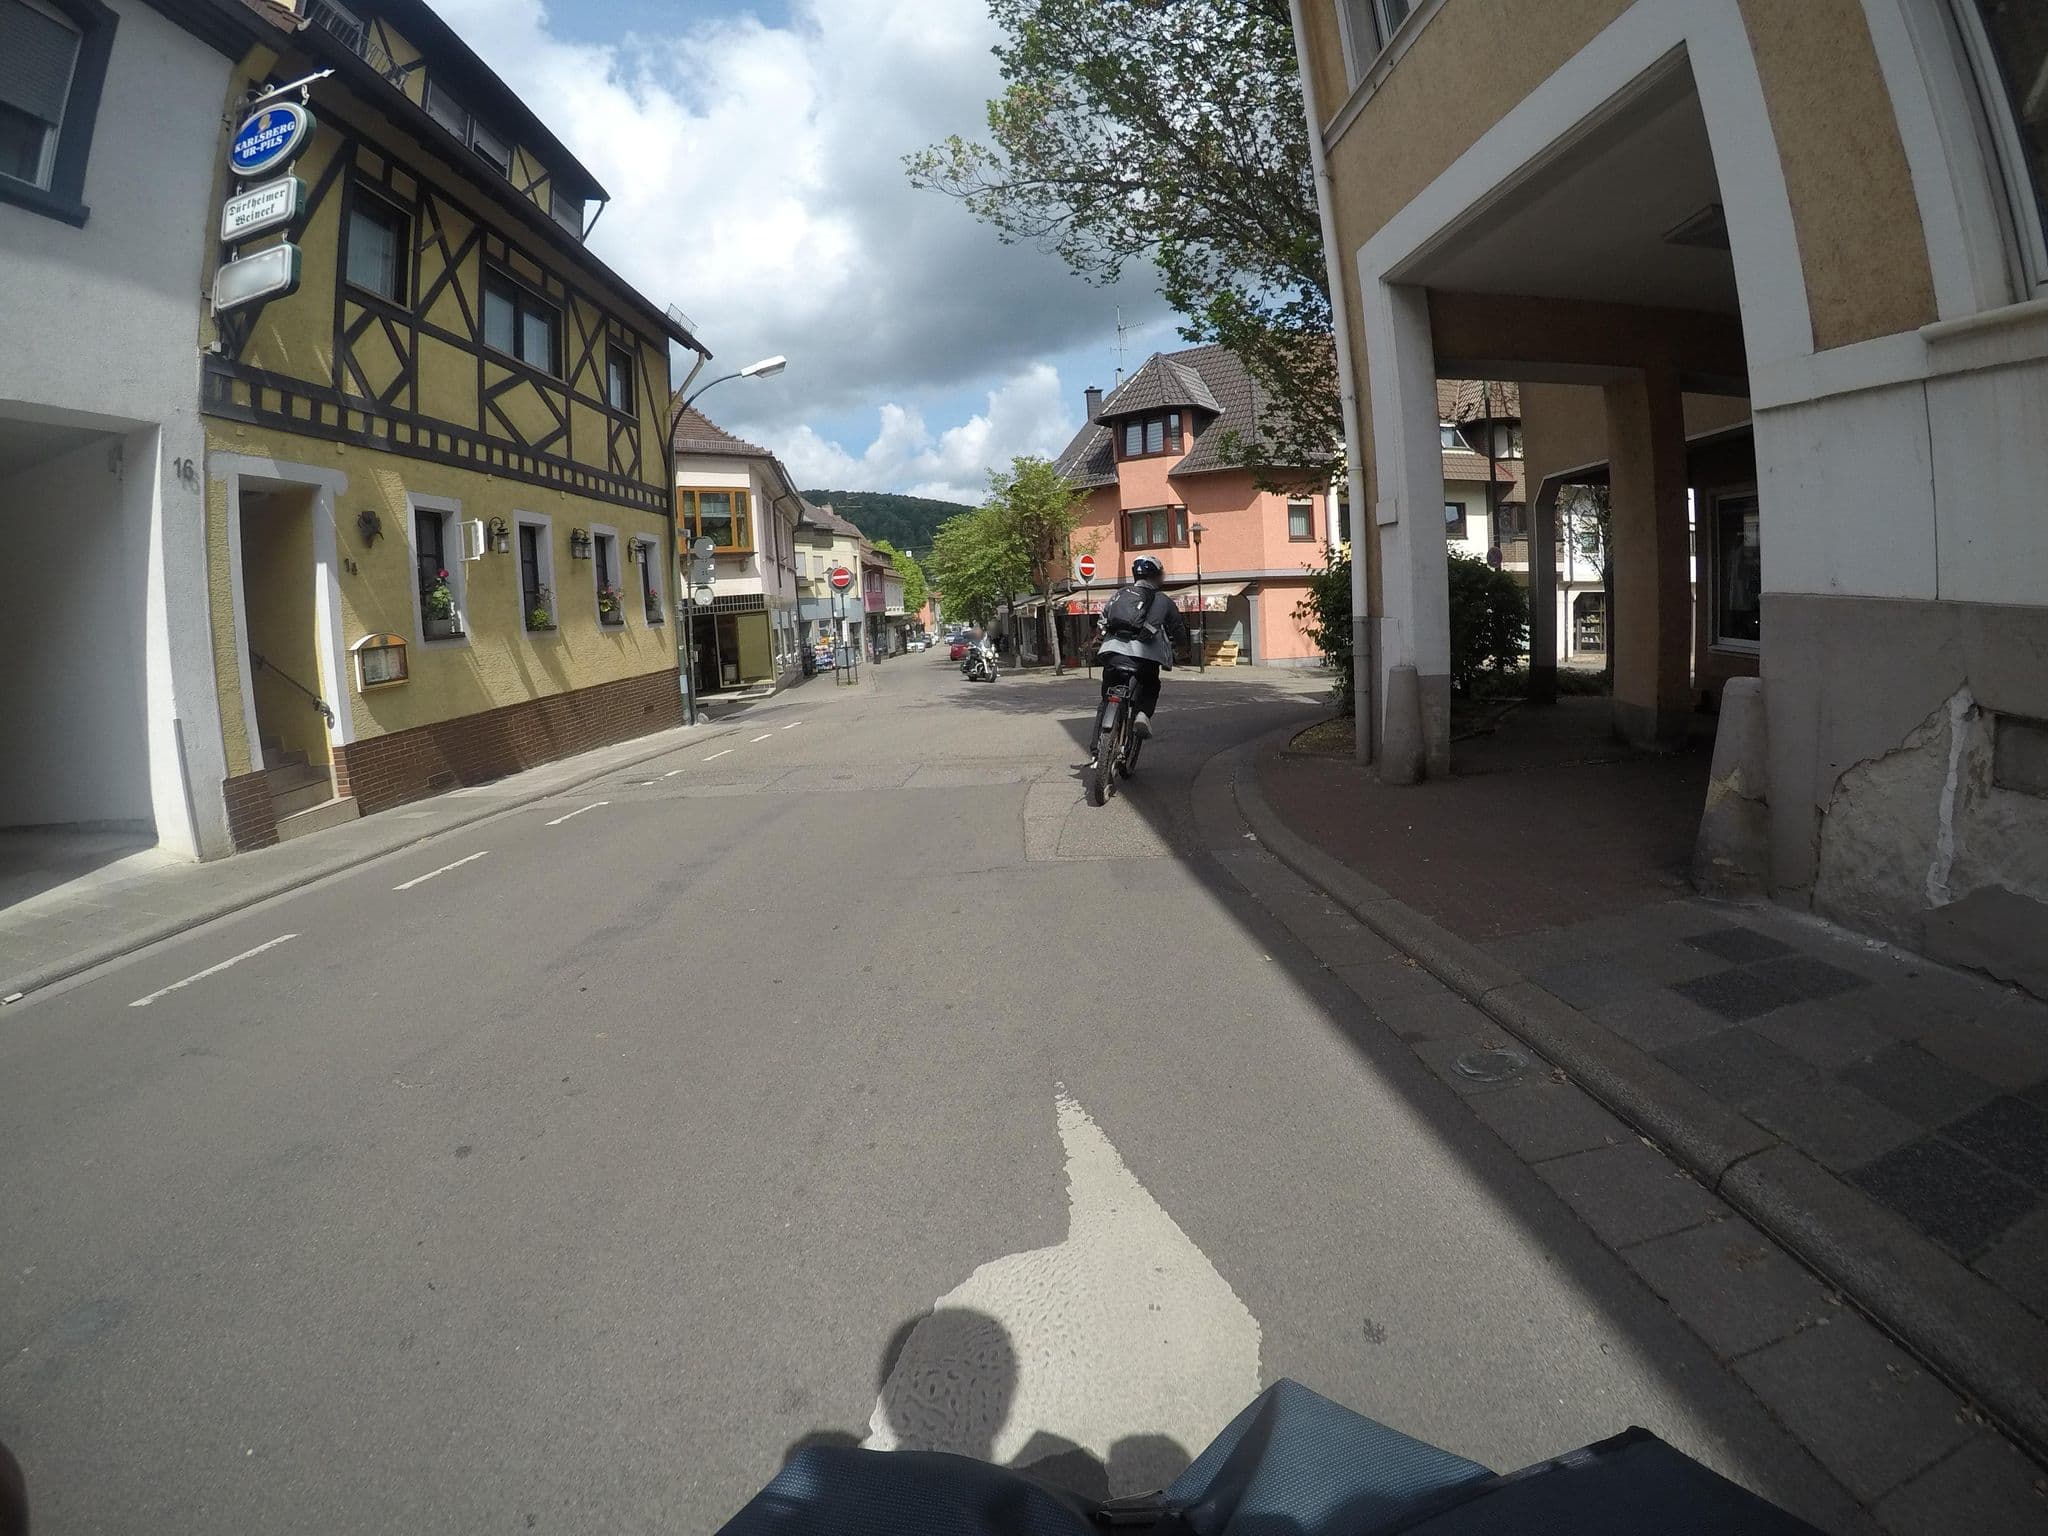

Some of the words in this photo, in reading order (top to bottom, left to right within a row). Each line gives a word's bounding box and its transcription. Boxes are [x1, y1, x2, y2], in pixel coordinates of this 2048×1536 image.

[234, 121, 295, 153] KARLSBERG
[242, 135, 283, 159] UR-PILS
[229, 190, 285, 216] Dürkheimer
[173, 456, 194, 480] 16
